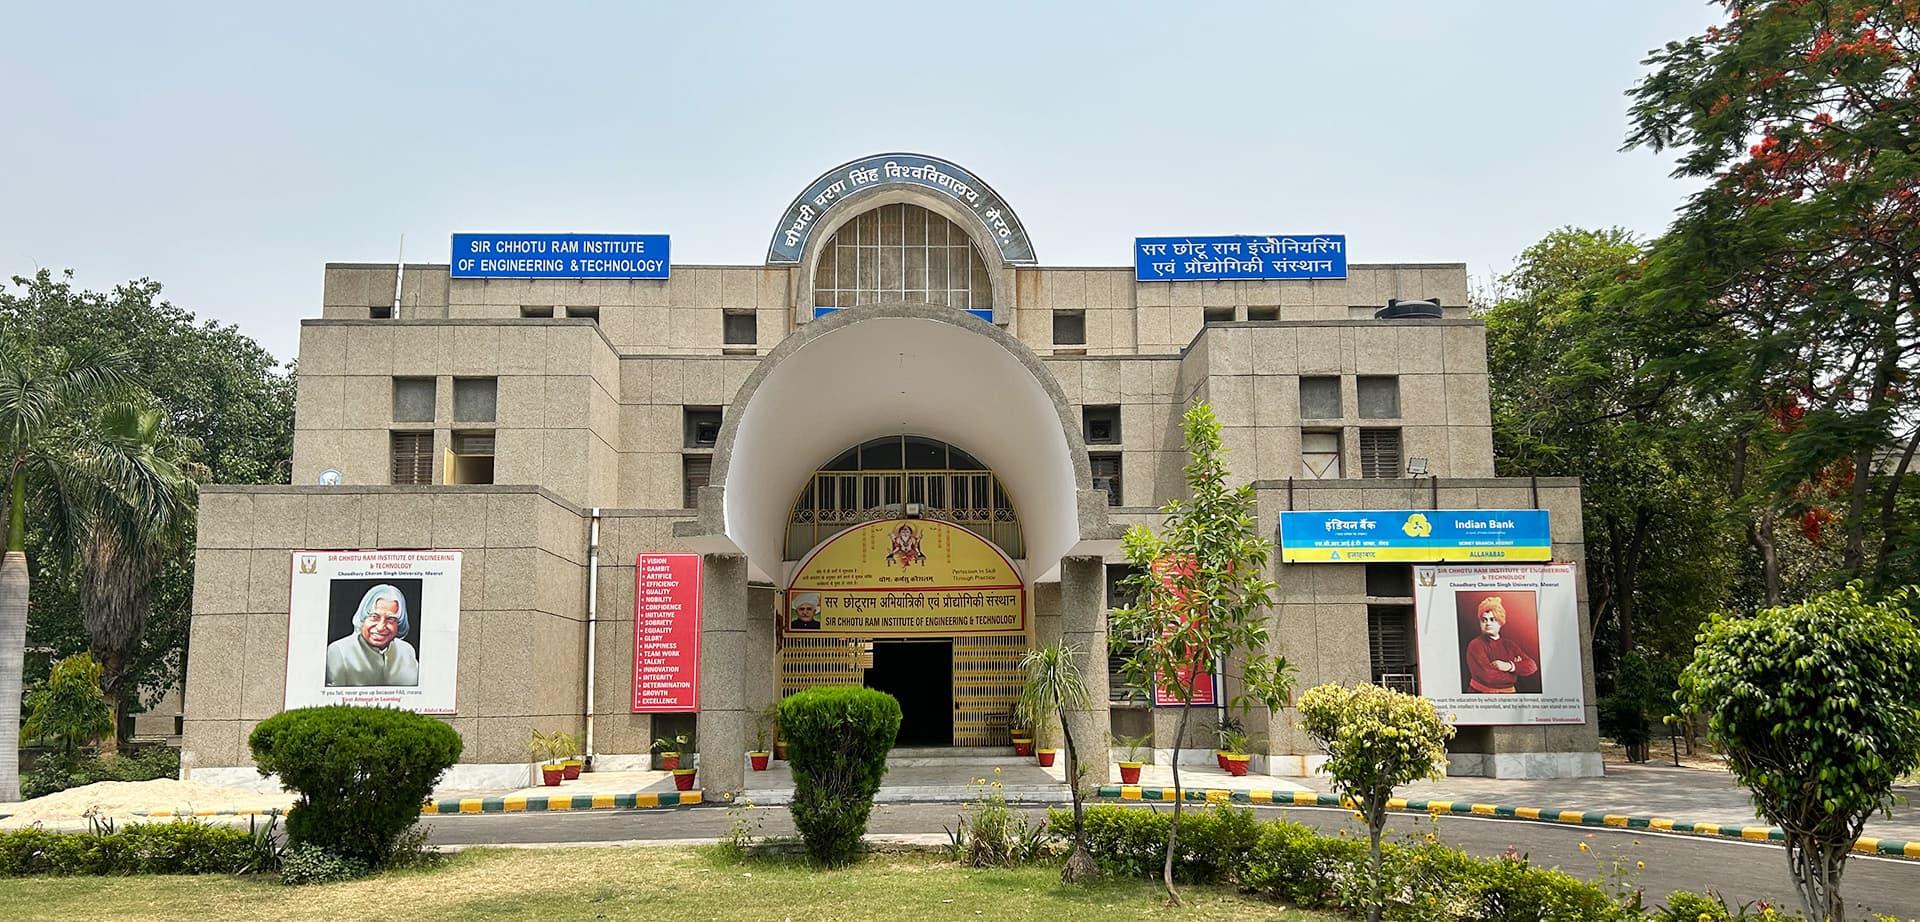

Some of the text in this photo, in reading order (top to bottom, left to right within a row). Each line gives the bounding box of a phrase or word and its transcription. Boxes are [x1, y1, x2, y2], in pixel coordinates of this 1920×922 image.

[785, 204, 816, 247] चौधरी
[813, 179, 846, 206] चरण
[848, 166, 879, 187] सिंह
[470, 240, 645, 254] SIR CHHOTU RAM INSTITUTE
[1141, 243, 1166, 256] सर
[1172, 239, 1208, 259] छोटू
[1212, 242, 1241, 255] राम
[458, 258, 475, 272] OF
[480, 258, 564, 272] ENGINEERING
[1152, 256, 1332, 276] एवं प्रौद्योगिकी संस्थान
[1325, 517, 1377, 532] इंडियन बैंक
[1455, 519, 1515, 529] Indian Bank
[824, 591, 1016, 613] सर छोटूराम अभियांत्रिकी एवं प्रौद्योगिकी संस्थान
[825, 615, 1016, 626] SIR CHHOTU RAM INSTITUTE OF ENGINEERING & TECHNOLOGY
